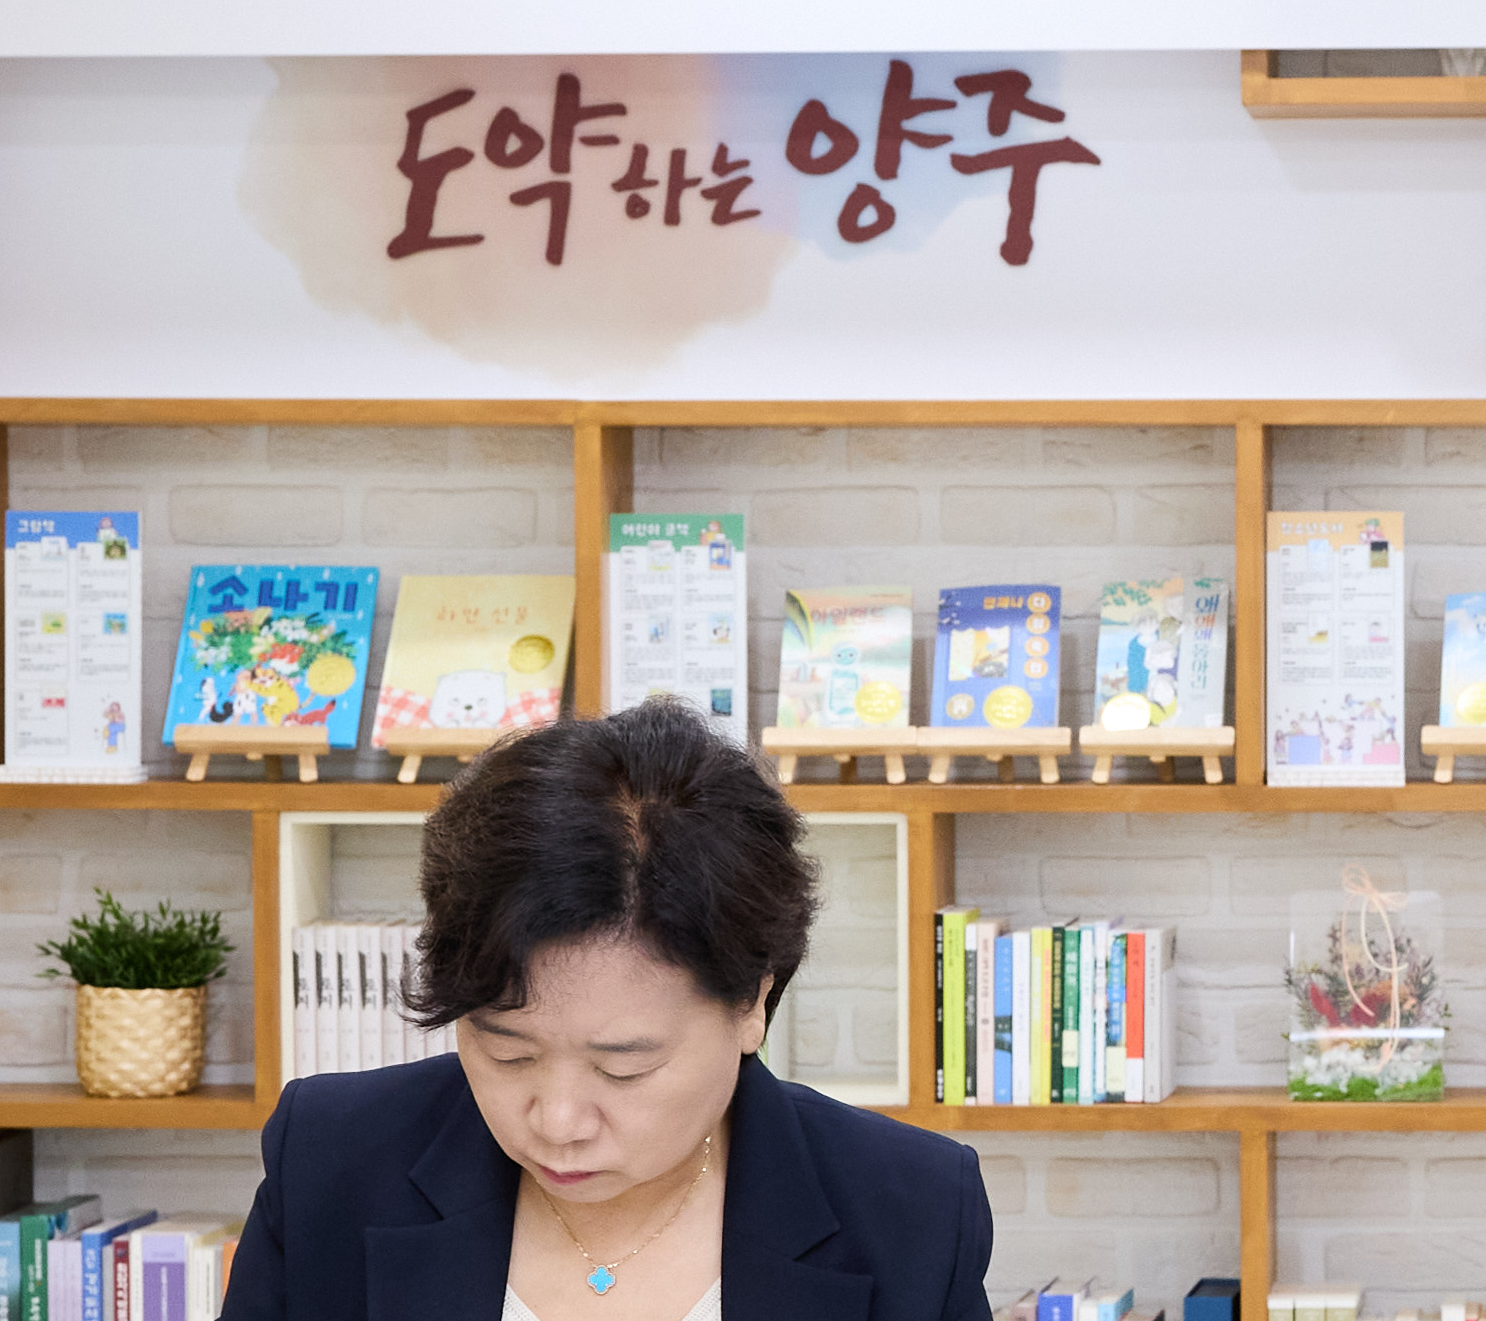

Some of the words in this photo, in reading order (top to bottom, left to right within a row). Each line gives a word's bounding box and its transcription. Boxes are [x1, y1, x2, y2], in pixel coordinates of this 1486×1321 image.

[385, 72, 764, 267] 도약하는
[785, 58, 1103, 267] 양주
[206, 573, 360, 616] 소나기
